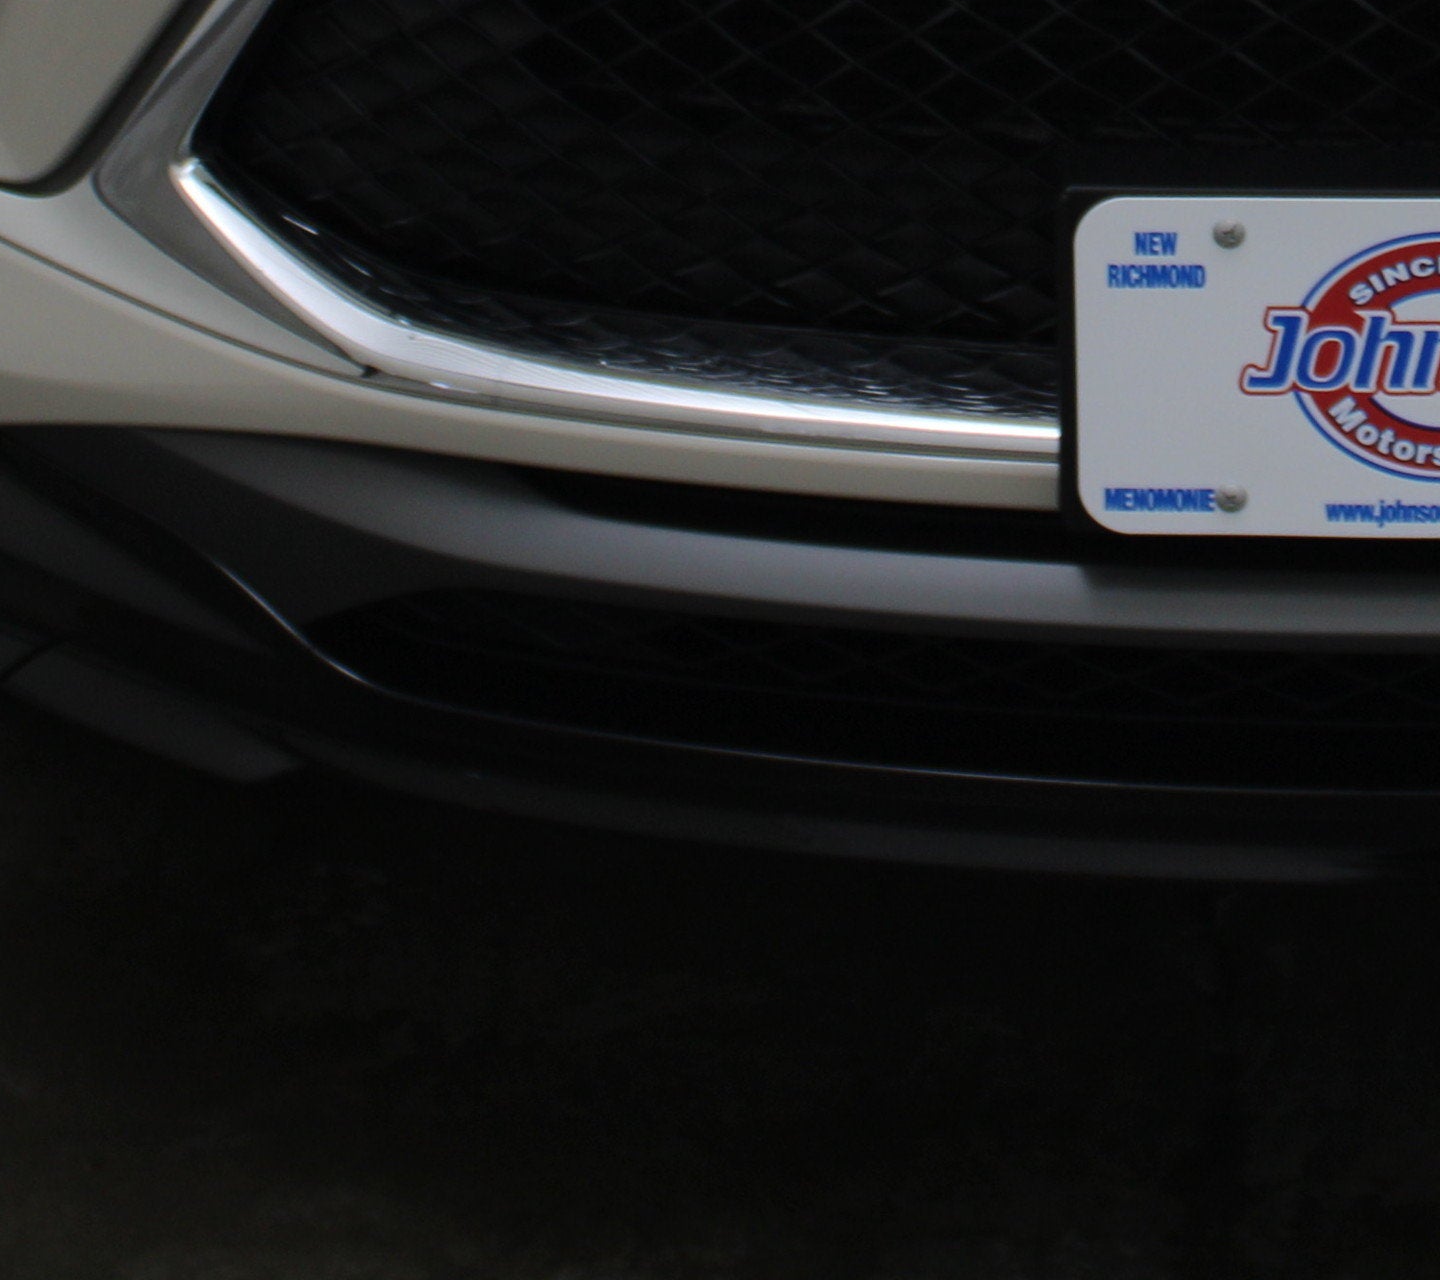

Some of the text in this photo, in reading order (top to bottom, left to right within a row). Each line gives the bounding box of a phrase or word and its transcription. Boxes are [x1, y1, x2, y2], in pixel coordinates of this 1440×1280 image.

[1134, 232, 1178, 256] NEW
[1107, 264, 1206, 288] RICHMOND
[1105, 487, 1216, 511] MENOMONIE
